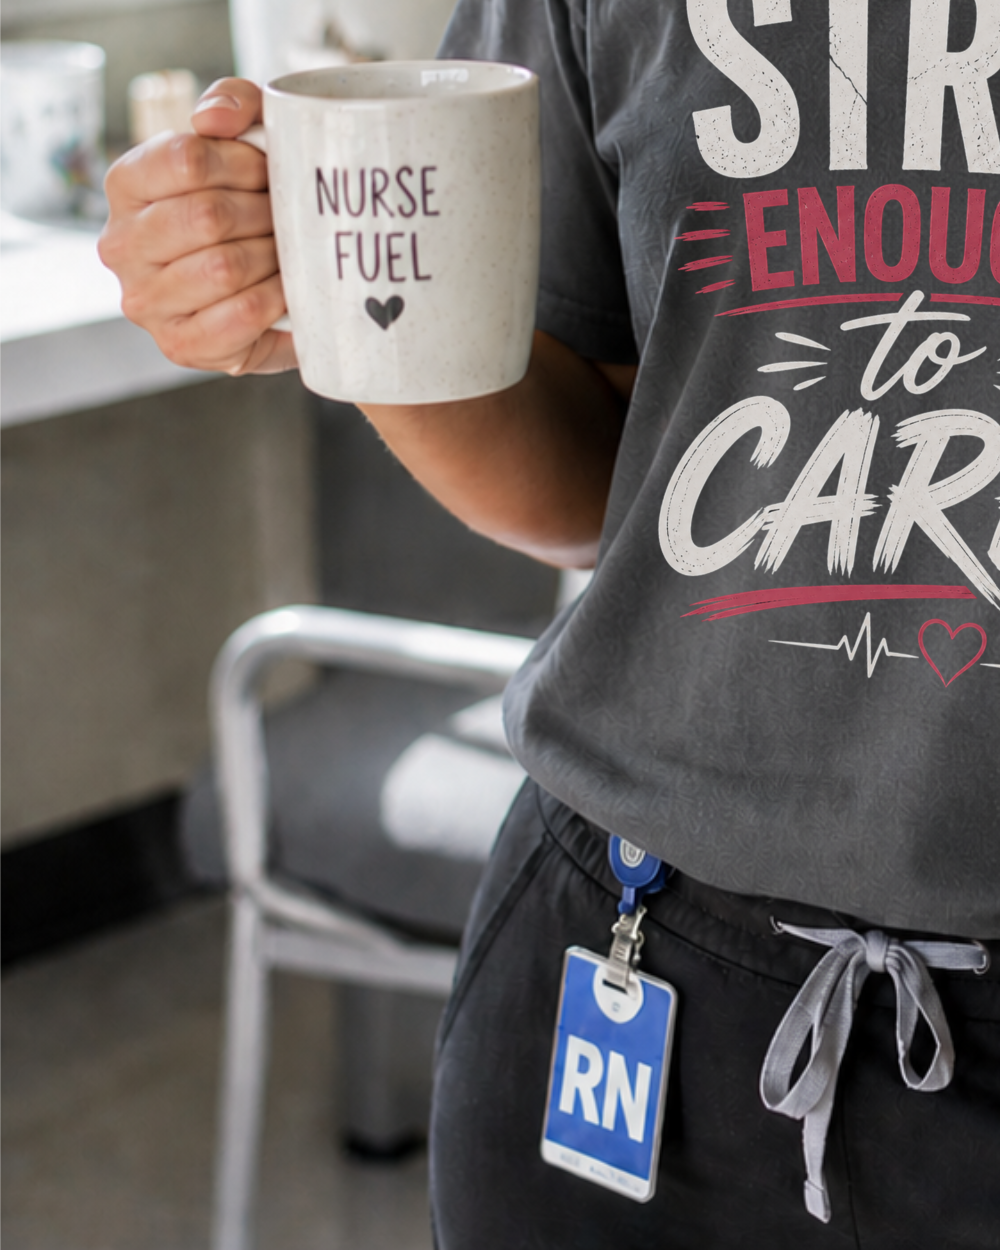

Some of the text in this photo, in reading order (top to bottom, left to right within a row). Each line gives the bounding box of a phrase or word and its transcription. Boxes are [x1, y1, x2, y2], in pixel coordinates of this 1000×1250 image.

[315, 166, 441, 219] NURSE
[334, 231, 432, 283] FUEL
[840, 290, 987, 401] to
[558, 1034, 652, 1143] RN
